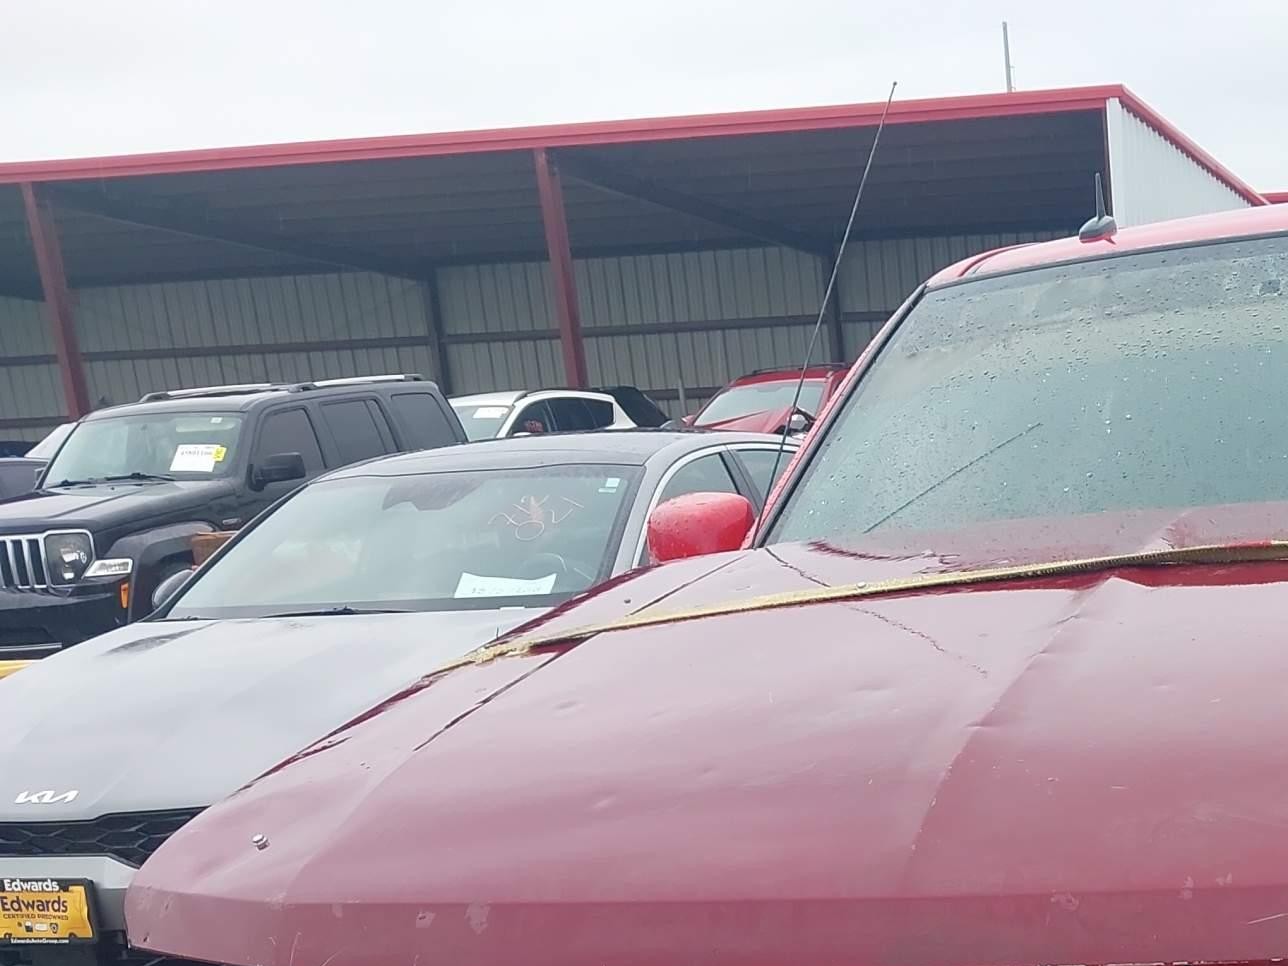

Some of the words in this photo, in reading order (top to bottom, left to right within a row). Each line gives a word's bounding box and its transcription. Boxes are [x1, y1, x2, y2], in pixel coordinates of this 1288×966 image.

[14, 790, 79, 804] KIA
[3, 879, 60, 892] Edwards
[0, 896, 68, 913] Edwards
